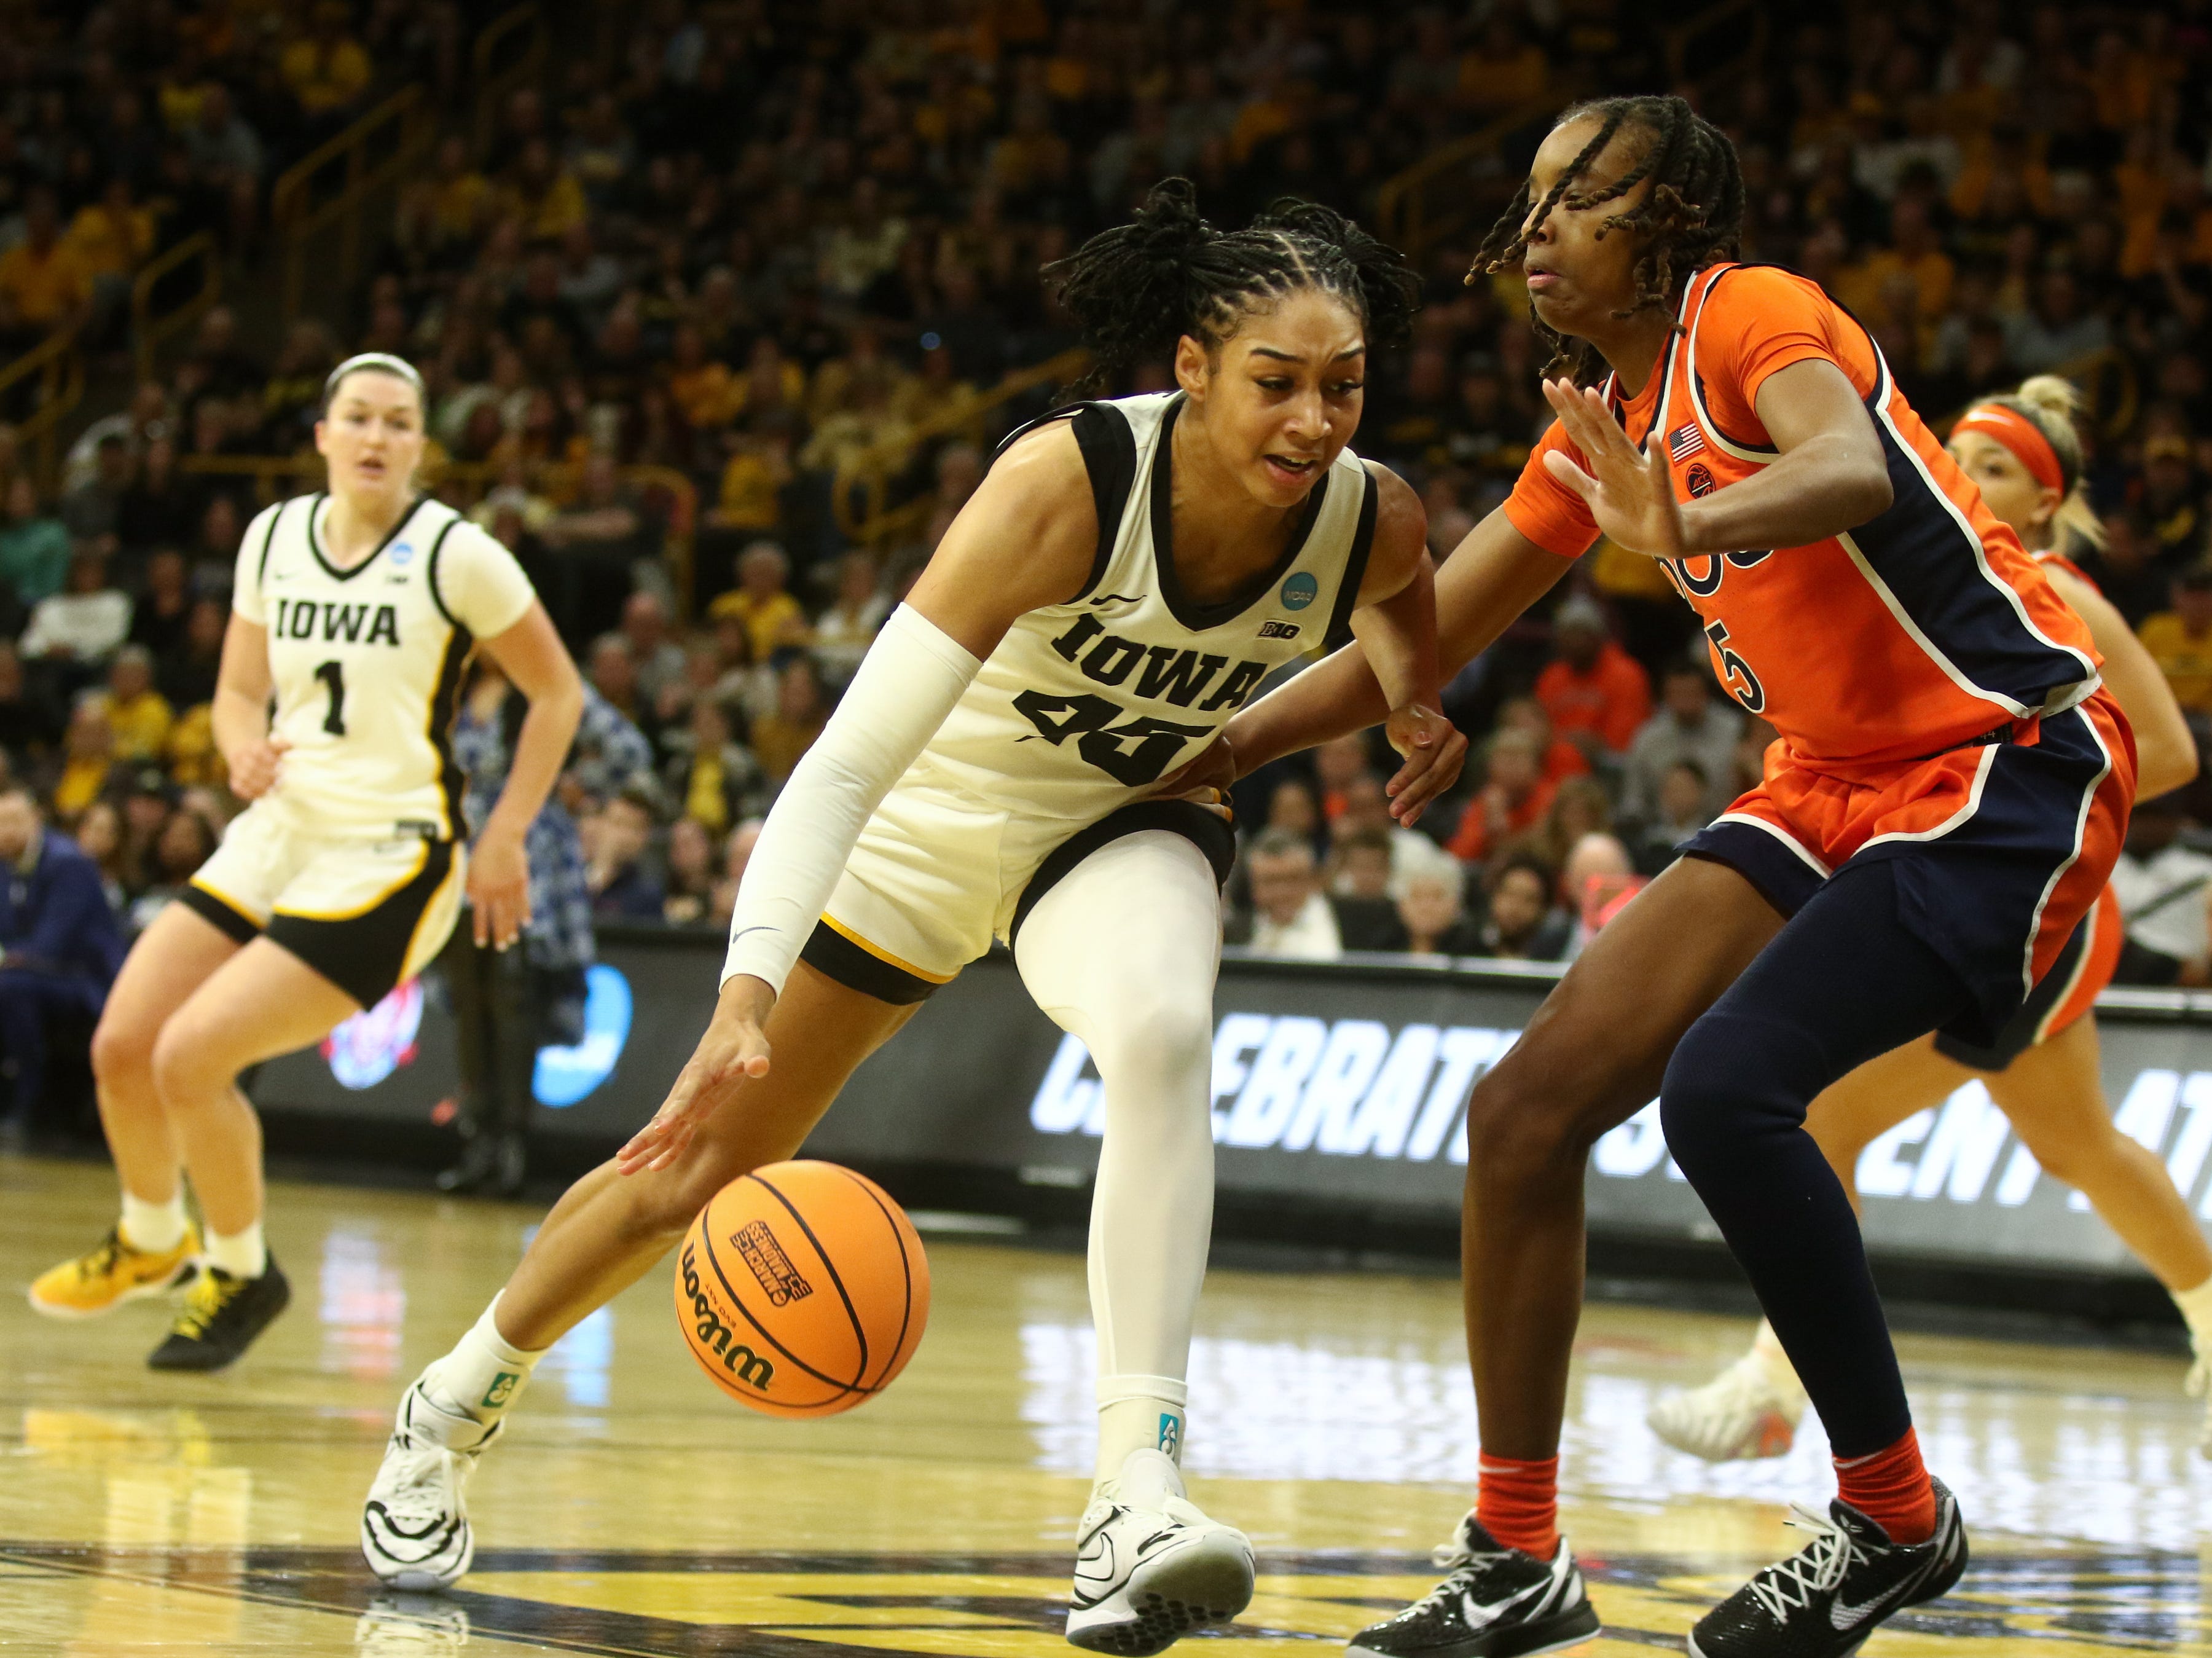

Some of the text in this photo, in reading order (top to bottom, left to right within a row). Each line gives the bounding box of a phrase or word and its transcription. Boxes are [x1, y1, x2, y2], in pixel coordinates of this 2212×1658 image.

[1693, 473, 1711, 490] ACC
[276, 598, 401, 646] IOWA
[1051, 612, 1268, 712] IOWA
[315, 660, 346, 736] 1
[1012, 689, 1217, 788] 45
[744, 1247, 782, 1294] MARCH
[745, 1220, 792, 1279] MADNESS
[682, 1239, 775, 1391] Wilson
